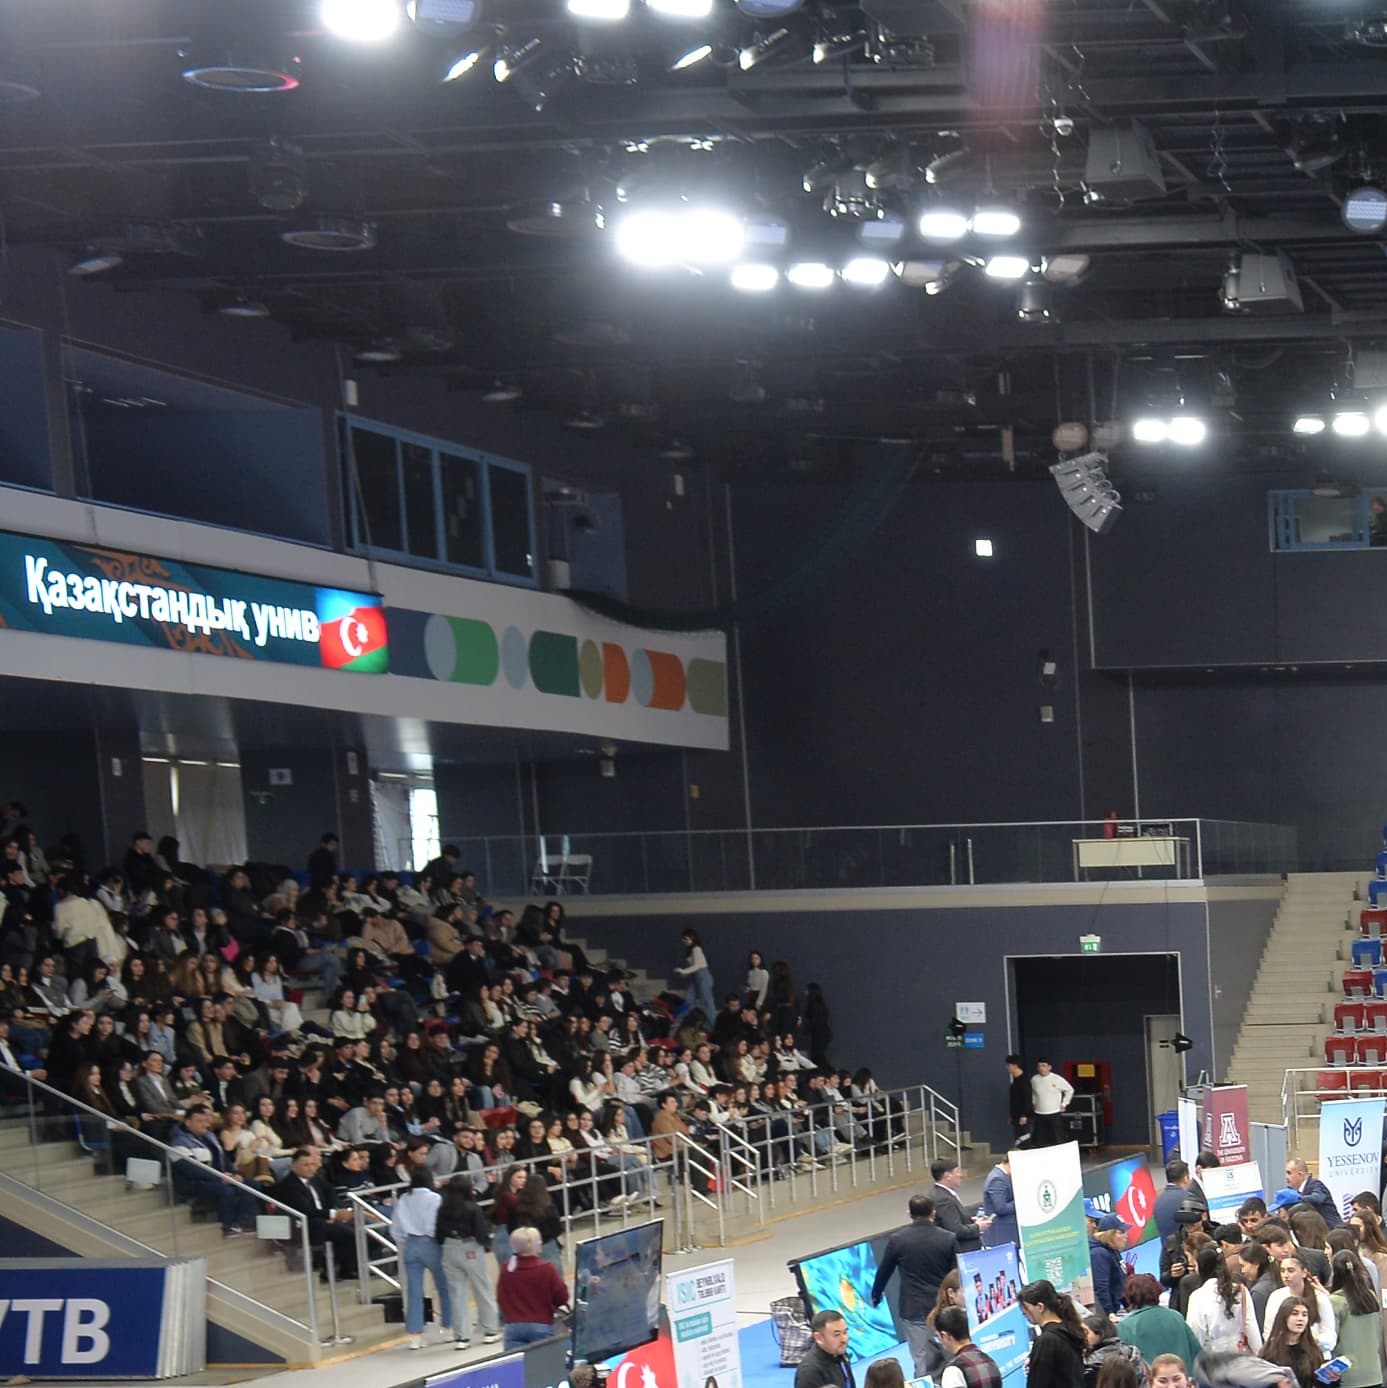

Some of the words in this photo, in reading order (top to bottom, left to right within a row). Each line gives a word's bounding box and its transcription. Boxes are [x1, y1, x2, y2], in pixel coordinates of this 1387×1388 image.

[24, 554, 252, 641] Қазақстандық
[251, 600, 321, 648] унив
[1327, 1151, 1381, 1168] YESSENOV
